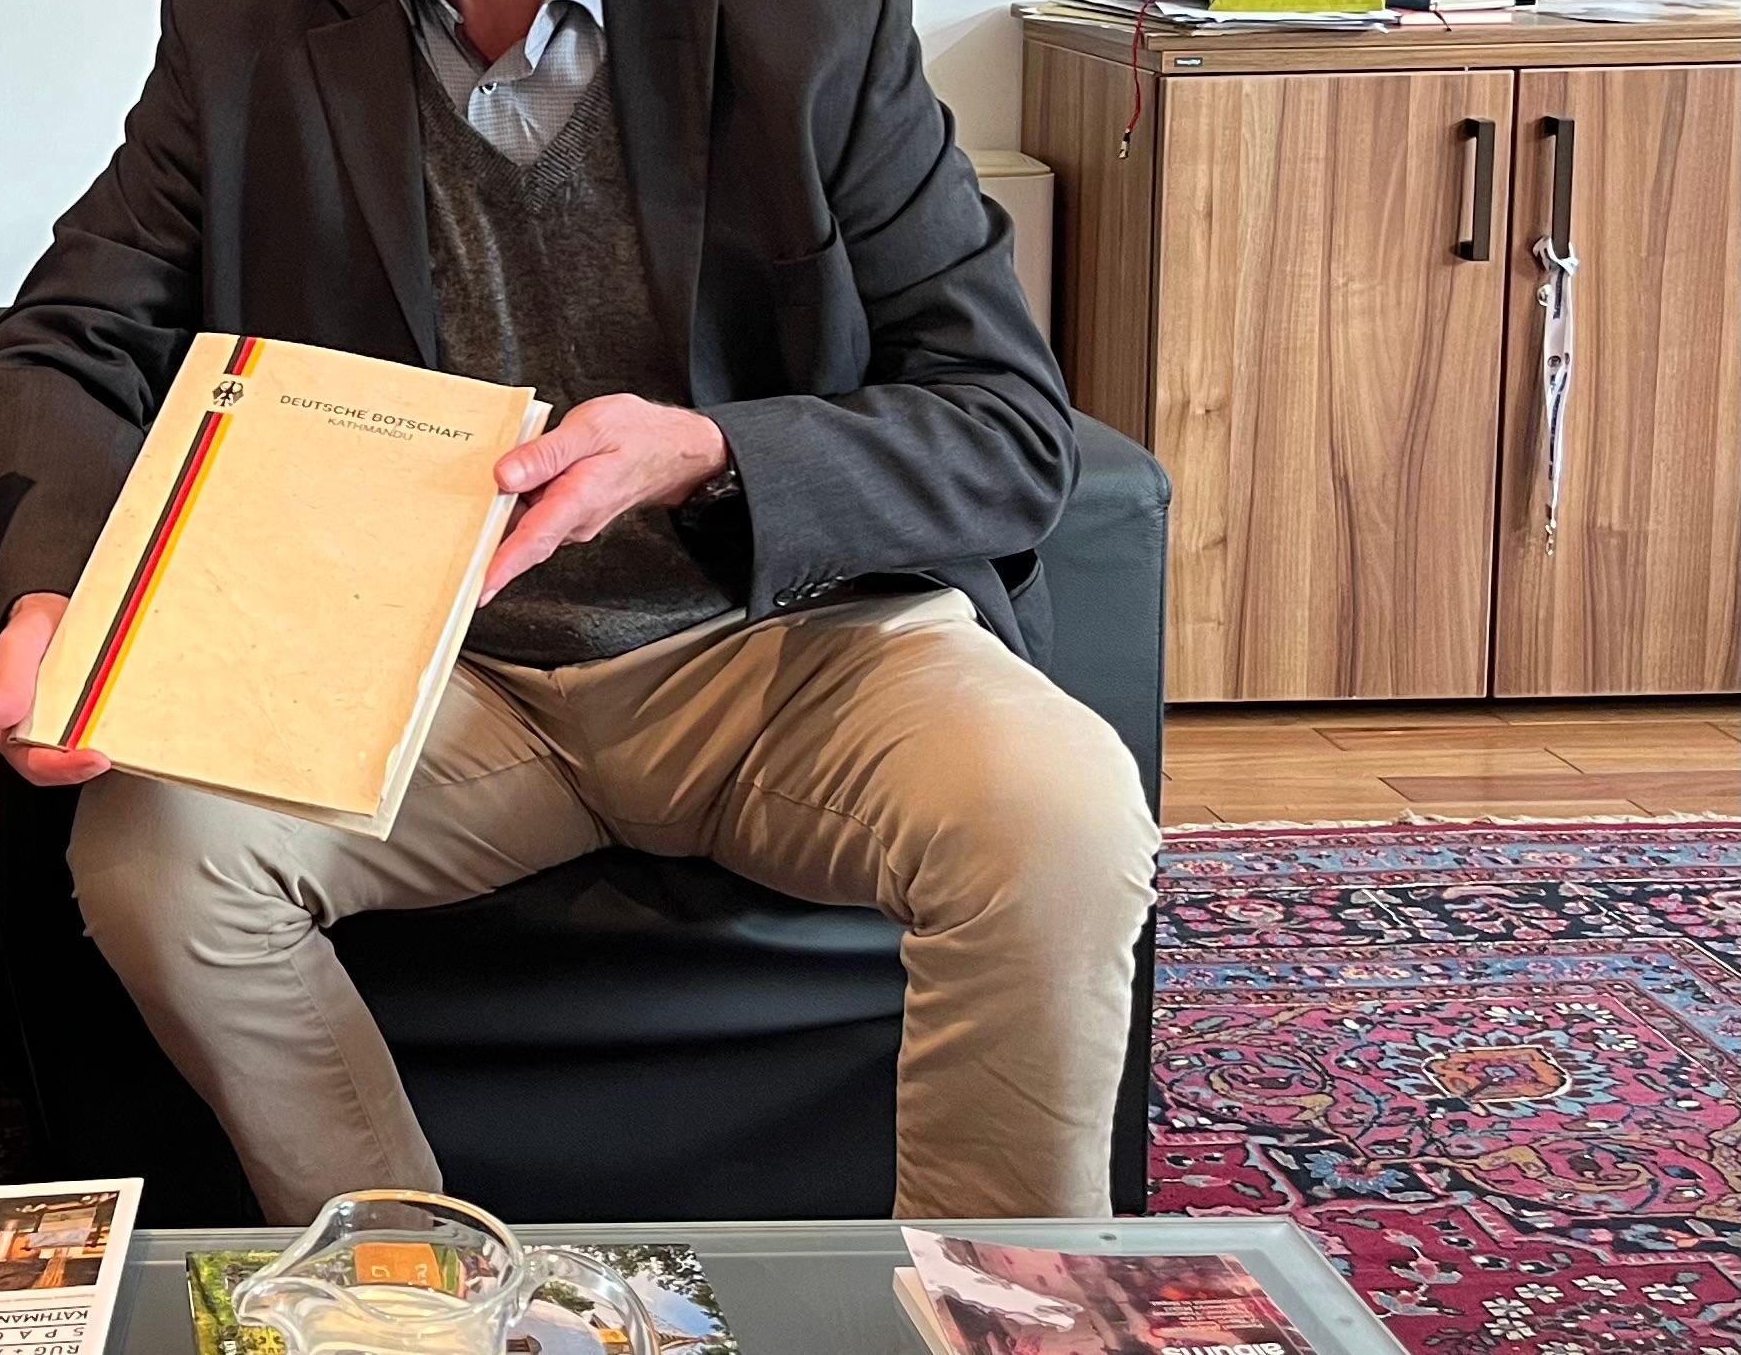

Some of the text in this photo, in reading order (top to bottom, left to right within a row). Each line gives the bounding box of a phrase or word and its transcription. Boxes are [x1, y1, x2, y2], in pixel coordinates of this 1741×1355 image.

[280, 395, 474, 442] DEUTSCHE BOTSCHAFT
[327, 418, 413, 441] KATHMANDU
[34, 1345, 80, 1355] RUG
